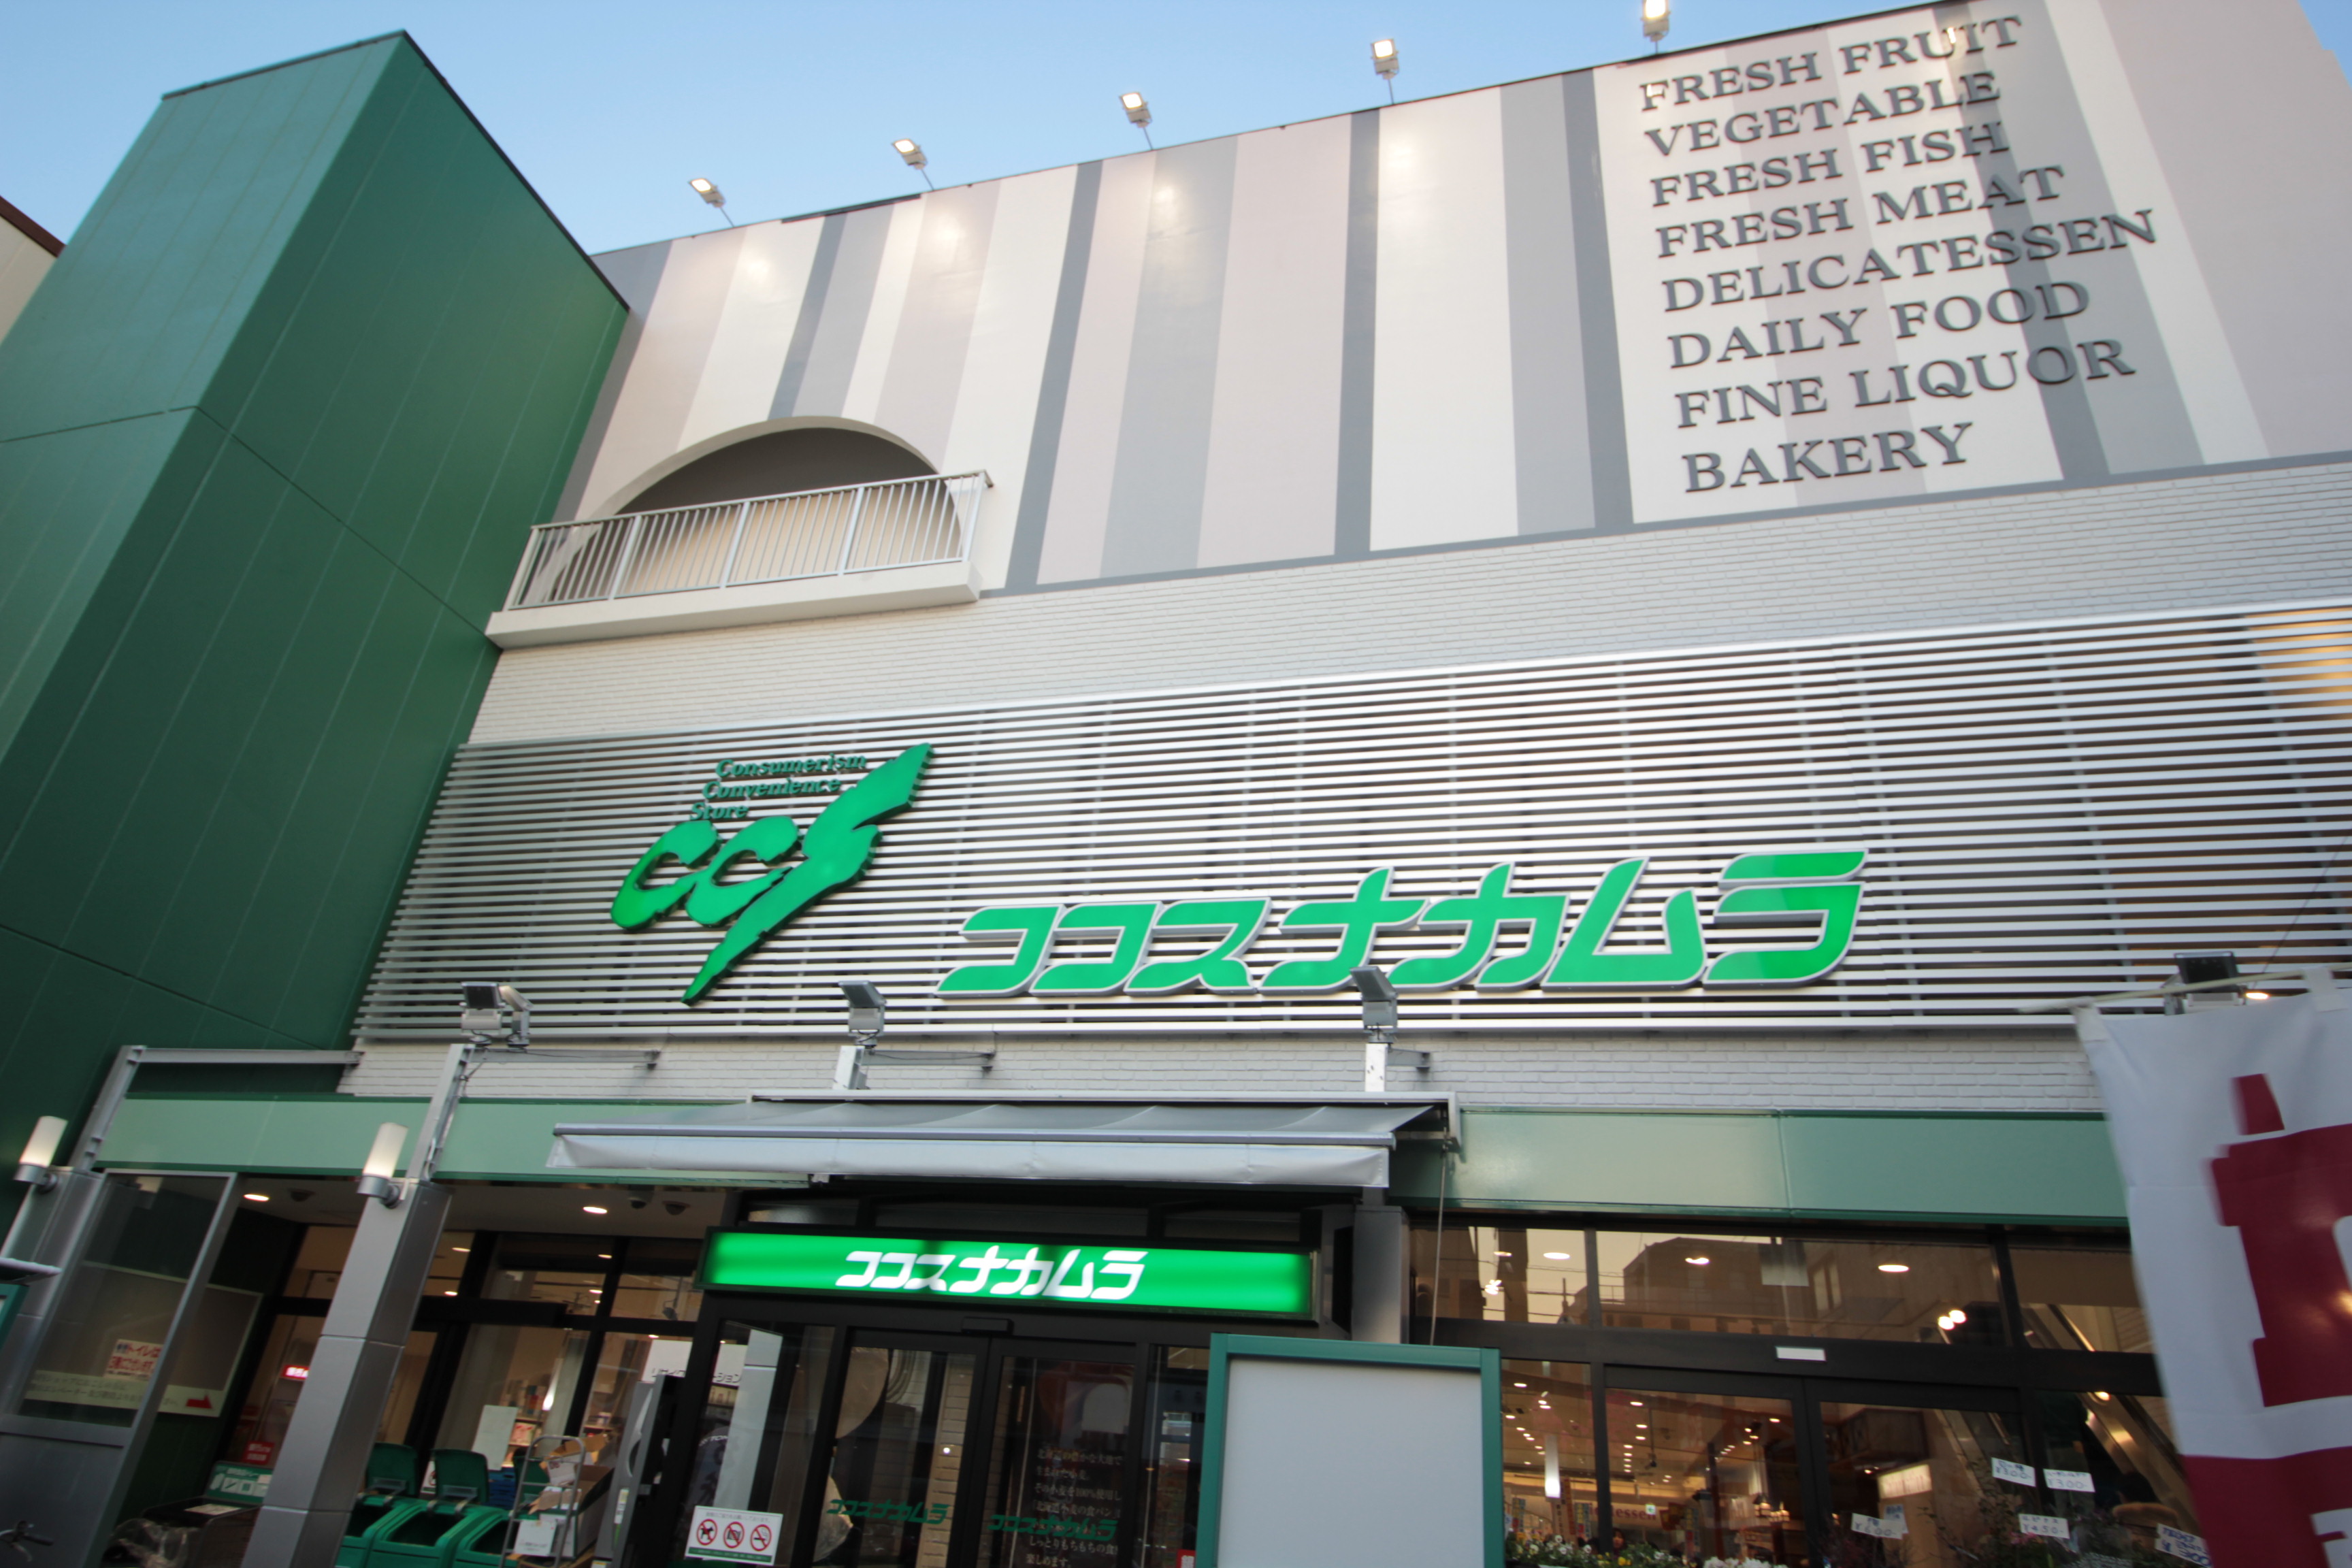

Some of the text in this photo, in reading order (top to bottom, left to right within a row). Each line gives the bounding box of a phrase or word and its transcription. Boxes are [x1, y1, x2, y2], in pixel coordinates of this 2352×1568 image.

[1640, 16, 2023, 111] FRESH FRUIT
[1645, 71, 2000, 157] VEGETABLE
[1651, 121, 2010, 207] FRESH FISH
[1656, 165, 2065, 257] FRESH MEAT
[1662, 209, 2158, 312] DELICATESSEN
[1668, 281, 2090, 368] DAILY FOOD
[1675, 339, 2136, 428] FINE LIQUOR
[1682, 422, 1973, 492] BAKERY
[702, 777, 841, 800] Convenience
[715, 753, 866, 777] Consumerism
[689, 802, 749, 821] Store
[936, 849, 1867, 998] ココスナカムラ
[835, 1245, 1149, 1300] ココスナカムラ
[826, 1498, 954, 1524] ココスナカムラ
[986, 1514, 1119, 1542] ココスナカムラ
